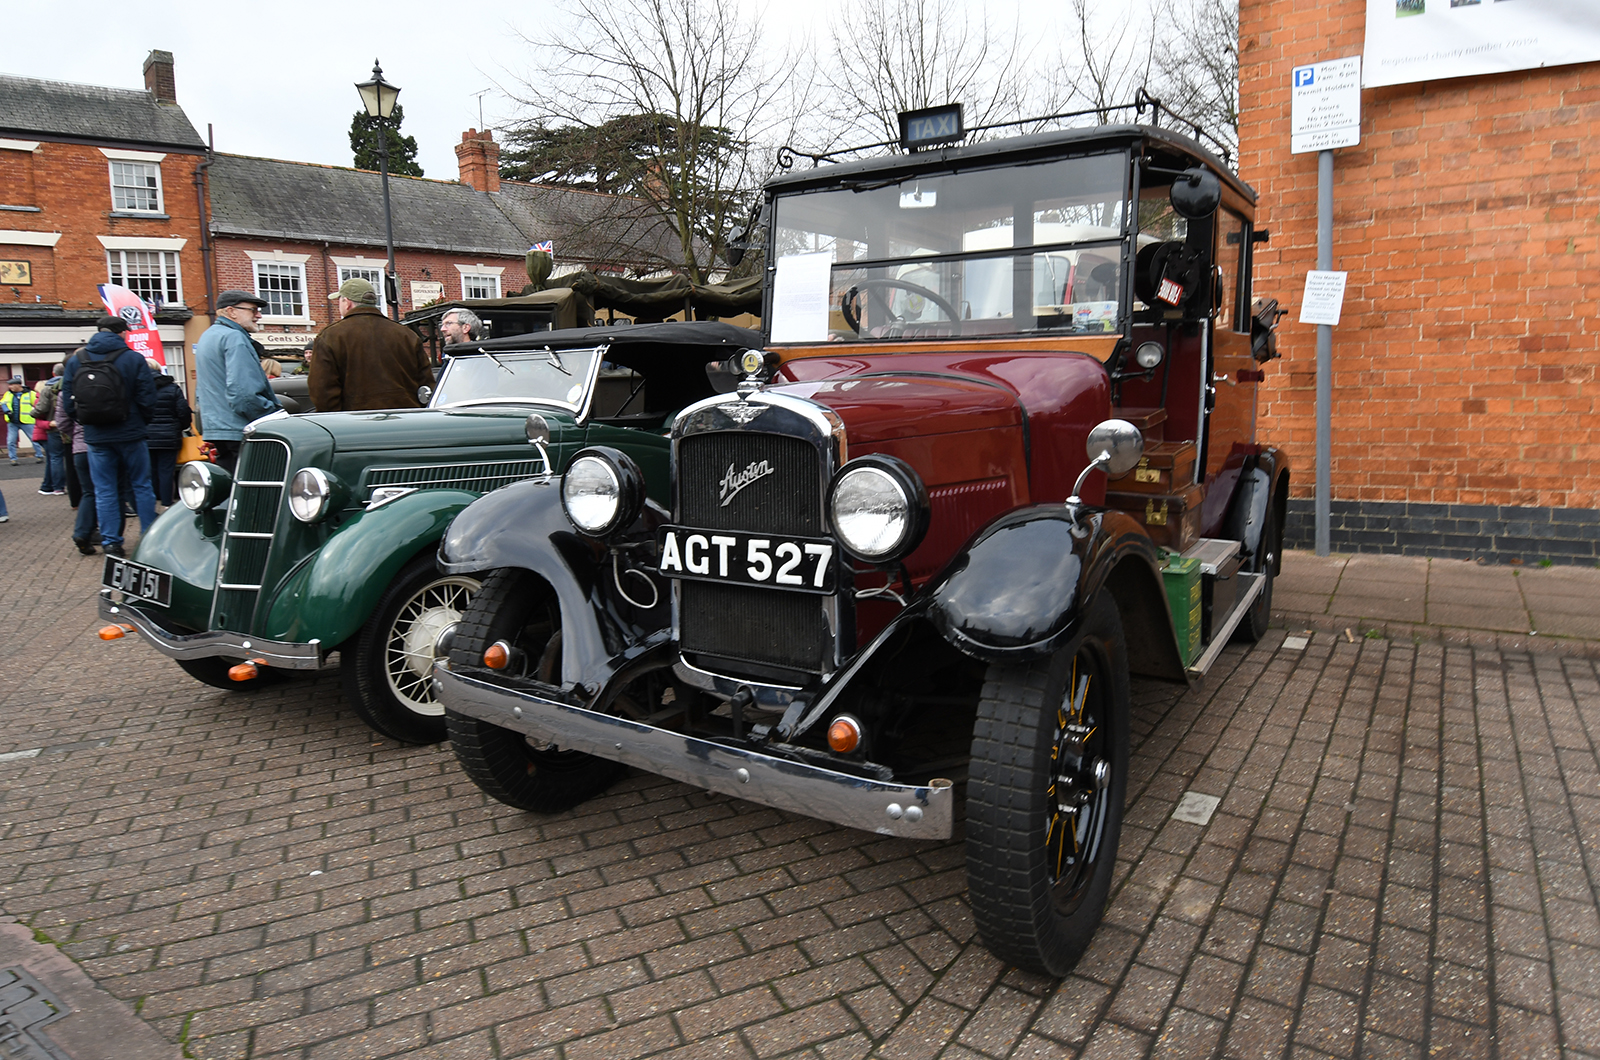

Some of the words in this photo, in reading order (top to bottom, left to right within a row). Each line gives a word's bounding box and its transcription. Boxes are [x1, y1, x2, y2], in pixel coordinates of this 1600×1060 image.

[1431, 48, 1463, 58] charity
[1465, 41, 1502, 55] number
[1297, 87, 1322, 97] Permit
[1325, 83, 1354, 92] Holders
[911, 114, 957, 138] TAXI
[1299, 123, 1322, 131] within
[1301, 141, 1330, 149] marked
[128, 333, 149, 342] JOIN
[719, 460, 774, 507] Austin
[660, 532, 736, 577] AGT
[746, 539, 833, 587] 527
[140, 571, 159, 599] 151
